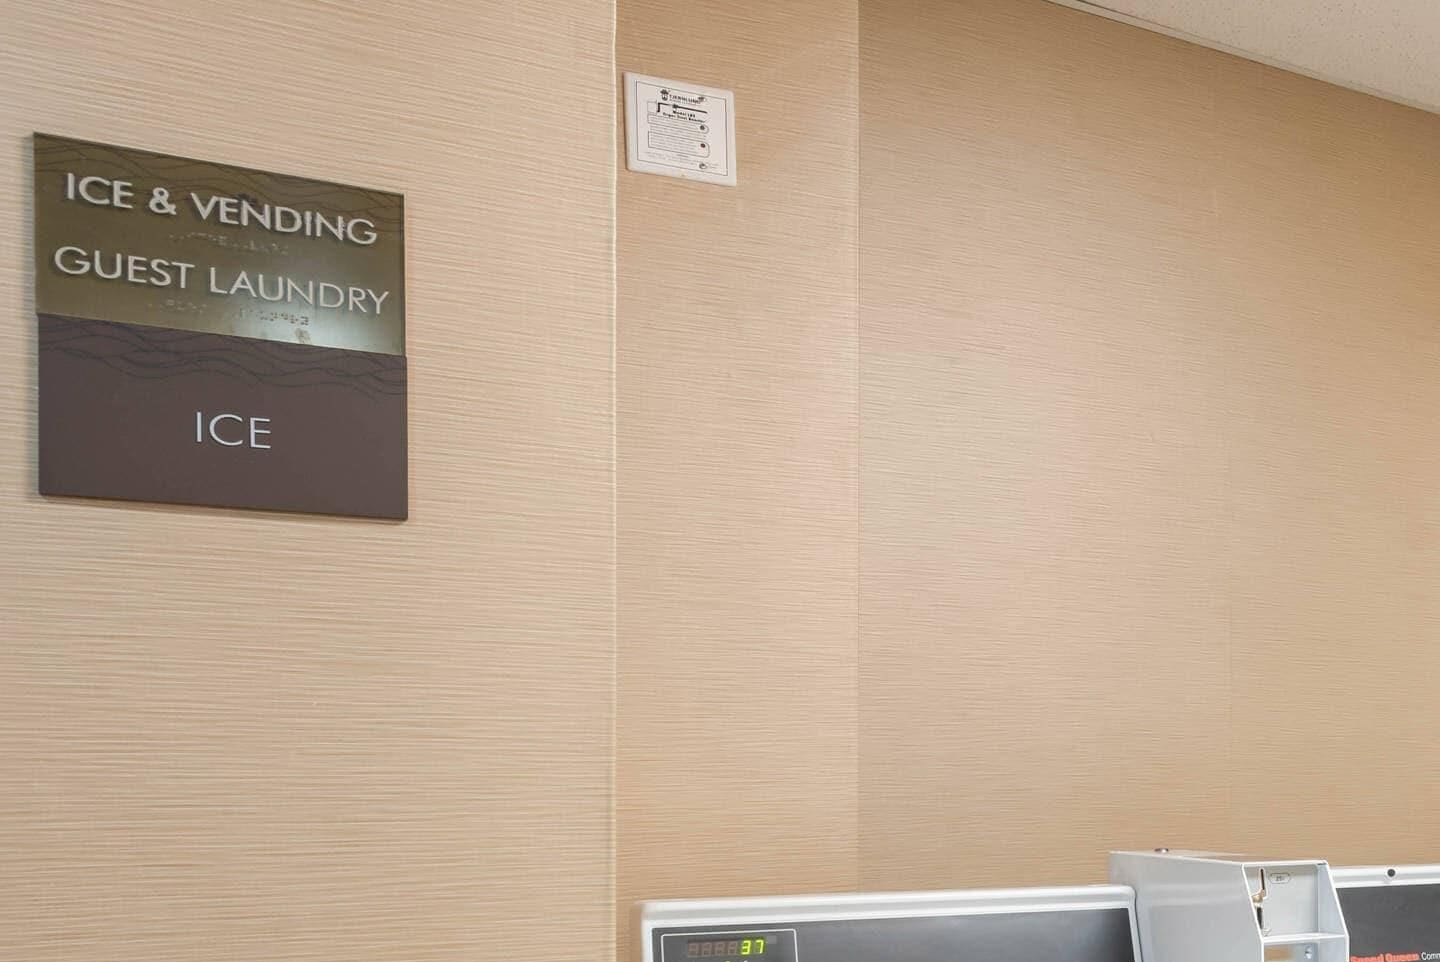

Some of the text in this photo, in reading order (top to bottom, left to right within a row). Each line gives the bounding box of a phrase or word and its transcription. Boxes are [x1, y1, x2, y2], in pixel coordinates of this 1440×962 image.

[66, 172, 378, 246] ICE & VENDING
[54, 246, 390, 315] GUEST LAUNDRY
[196, 411, 272, 450] ICE
[741, 939, 765, 955] 37
[1385, 952, 1420, 962] Queen
